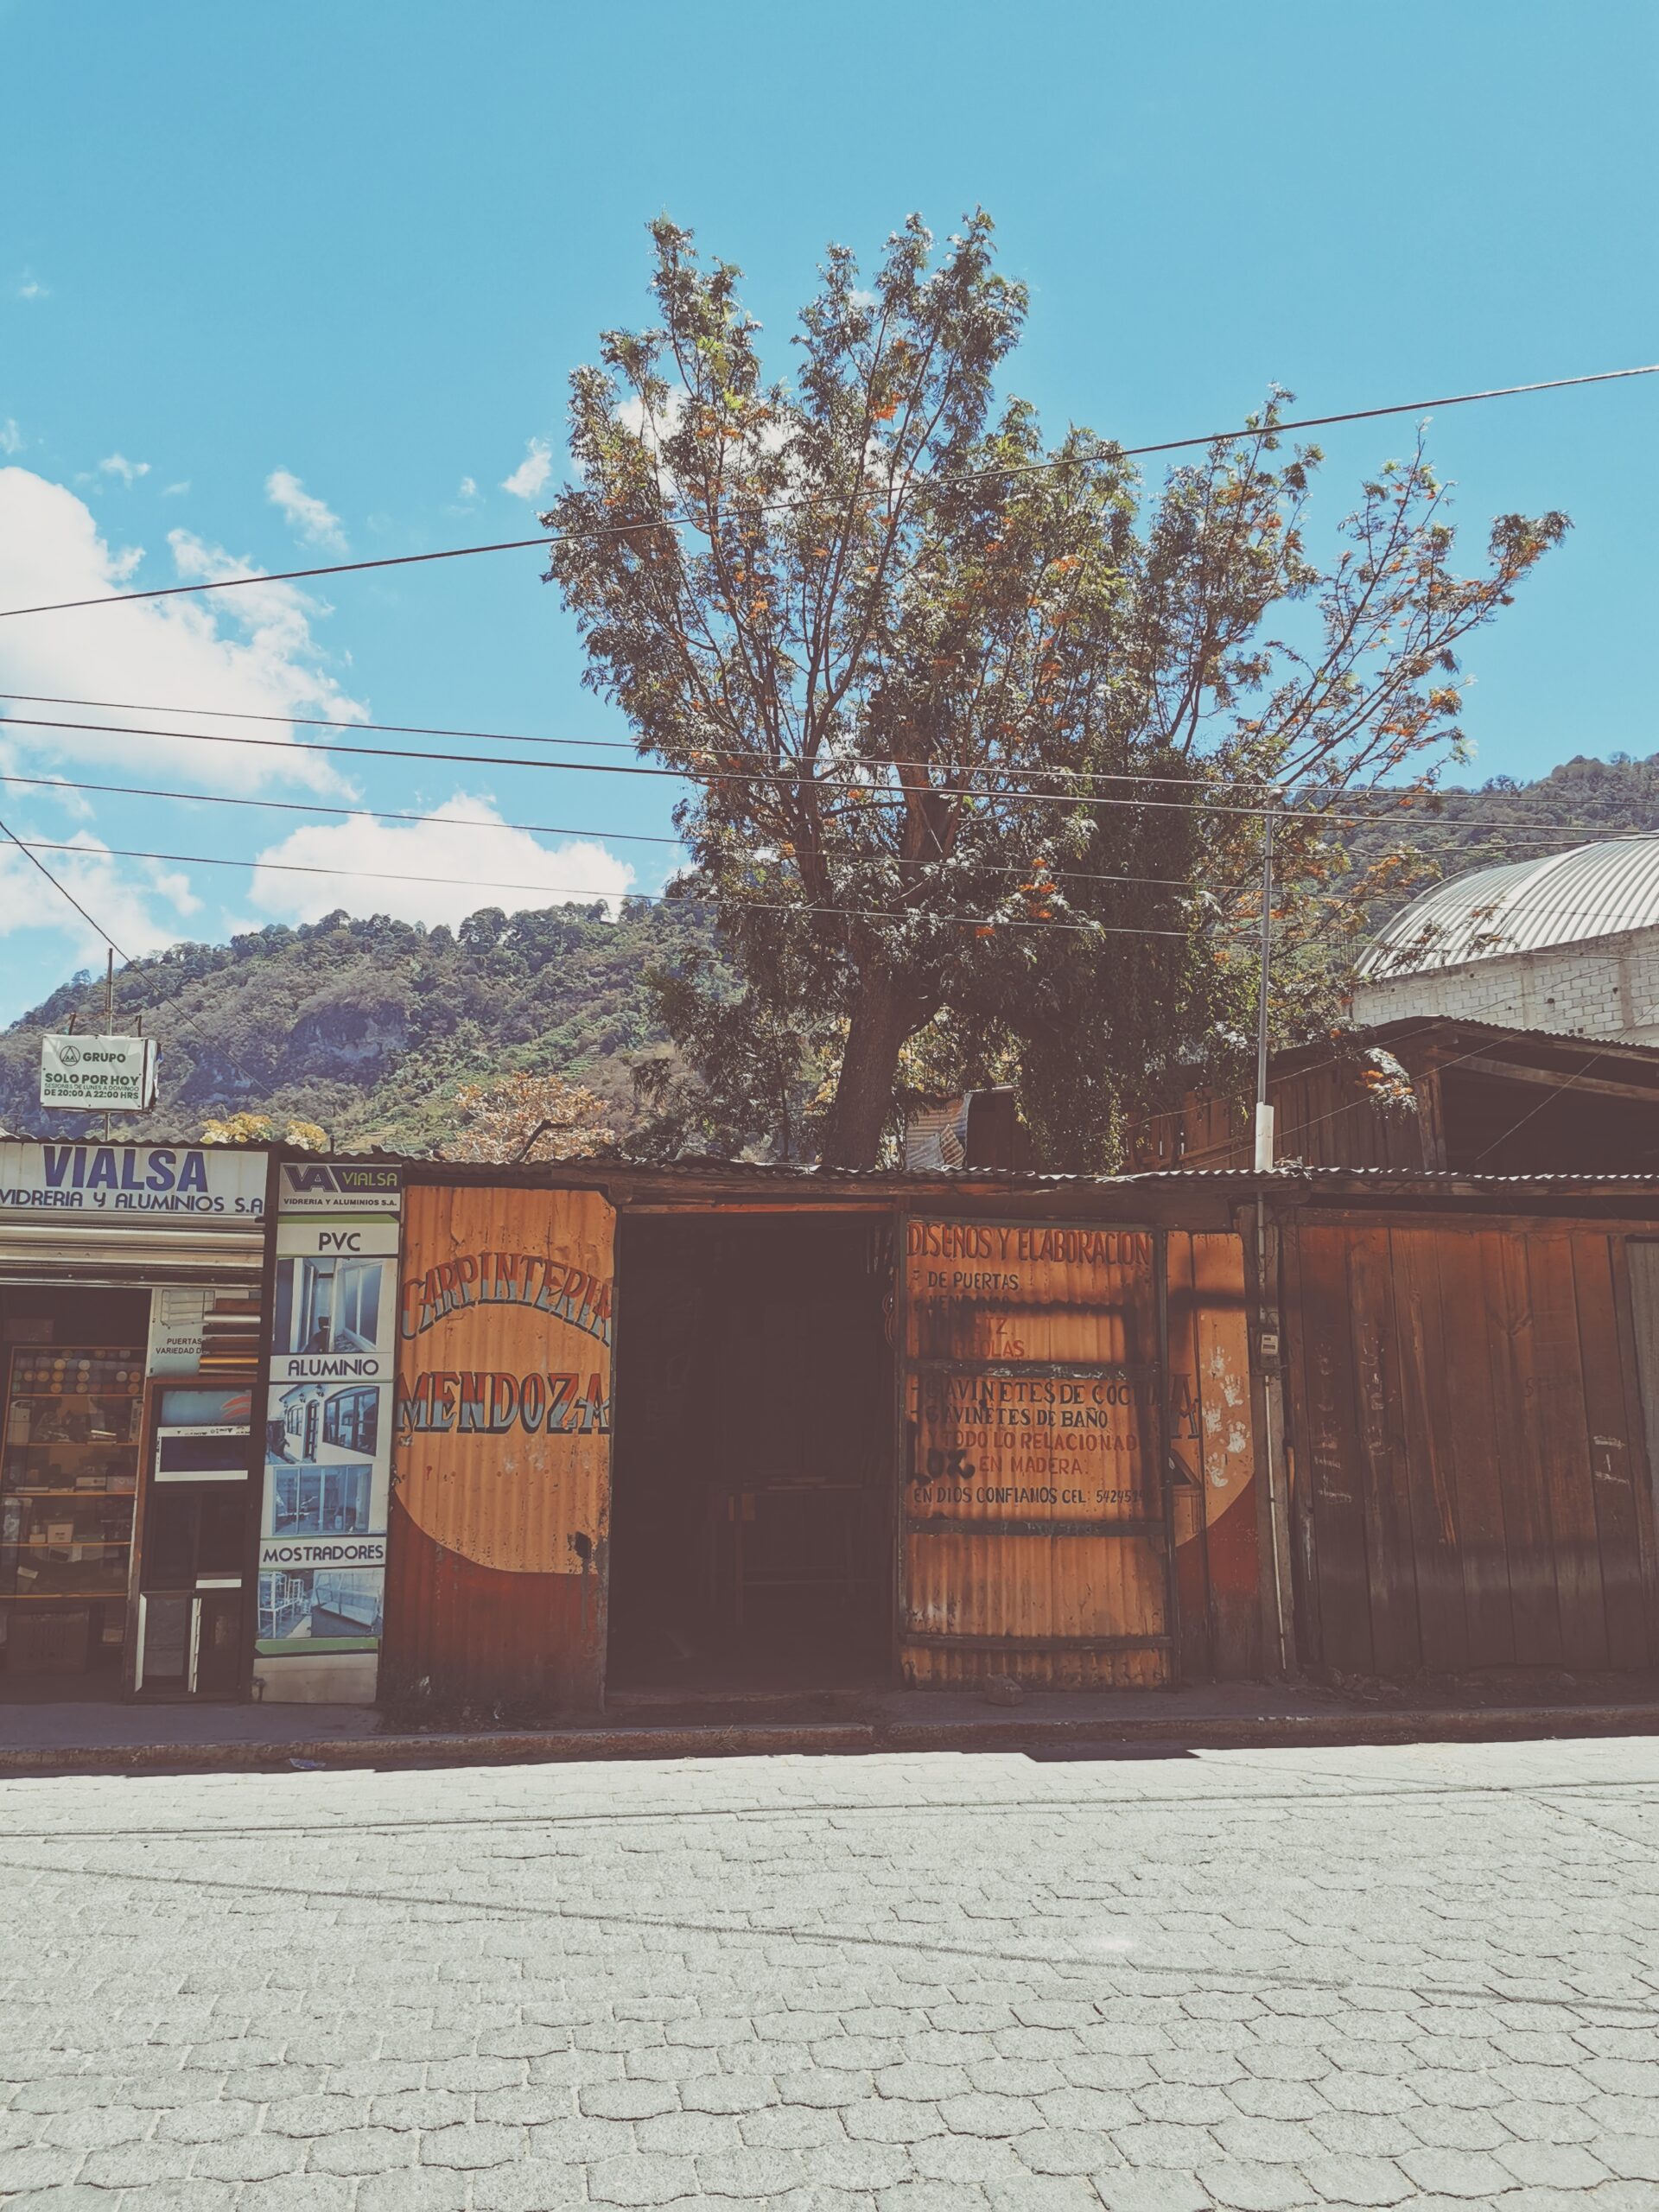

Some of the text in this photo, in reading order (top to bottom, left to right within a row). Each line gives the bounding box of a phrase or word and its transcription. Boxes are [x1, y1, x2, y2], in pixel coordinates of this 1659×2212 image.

[83, 1052, 126, 1063] GRUPO
[45, 1073, 139, 1085] SOLO POR HOY
[43, 1146, 208, 1192] VIALSA
[342, 1172, 397, 1186] VIALSA
[0, 1189, 83, 1206] VIDRERIA
[115, 1192, 224, 1211] ALUMINIOS
[318, 1232, 361, 1252] PVC
[998, 1227, 1011, 1261] Y
[928, 1271, 947, 1287] DE
[401, 1252, 612, 1347] CARPINTERIA
[288, 1359, 379, 1376] ALUMINIO
[397, 1371, 610, 1434] MENDOZA
[1060, 1384, 1085, 1405] DE
[1037, 1409, 1056, 1427] DE
[1061, 1408, 1108, 1428] BAÑO
[943, 1430, 988, 1449] TODO
[994, 1431, 1015, 1449] LO
[979, 1455, 1002, 1472] EN
[914, 1487, 932, 1503] EN
[937, 1487, 972, 1504] DIOS
[976, 1487, 1058, 1505] CONFIAMOS
[263, 1545, 384, 1562] MOSTRADORES
